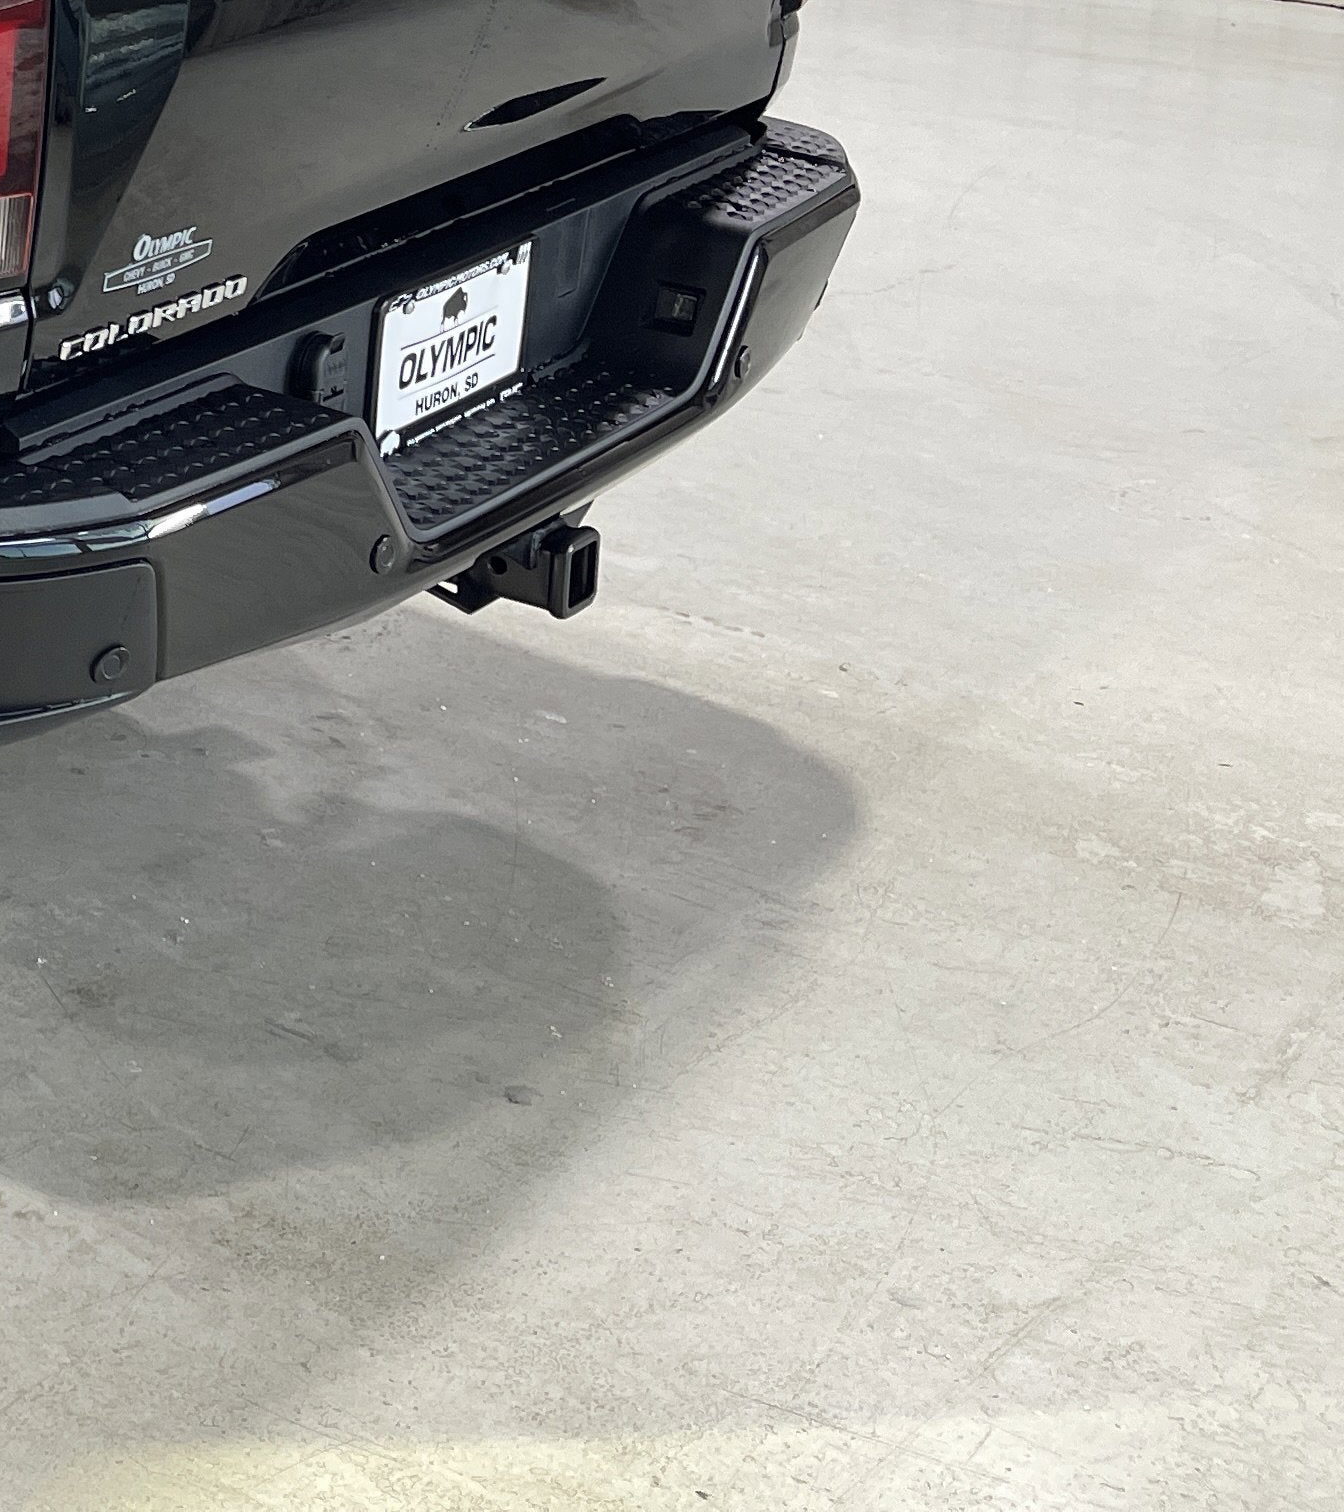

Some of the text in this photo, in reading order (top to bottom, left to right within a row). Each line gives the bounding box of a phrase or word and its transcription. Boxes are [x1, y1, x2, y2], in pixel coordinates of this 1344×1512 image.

[133, 227, 197, 261] OLYMPIC
[59, 274, 248, 361] COLORADO
[399, 315, 498, 390] OLYMPIC
[415, 381, 461, 416] HURON,
[464, 372, 479, 392] SD
